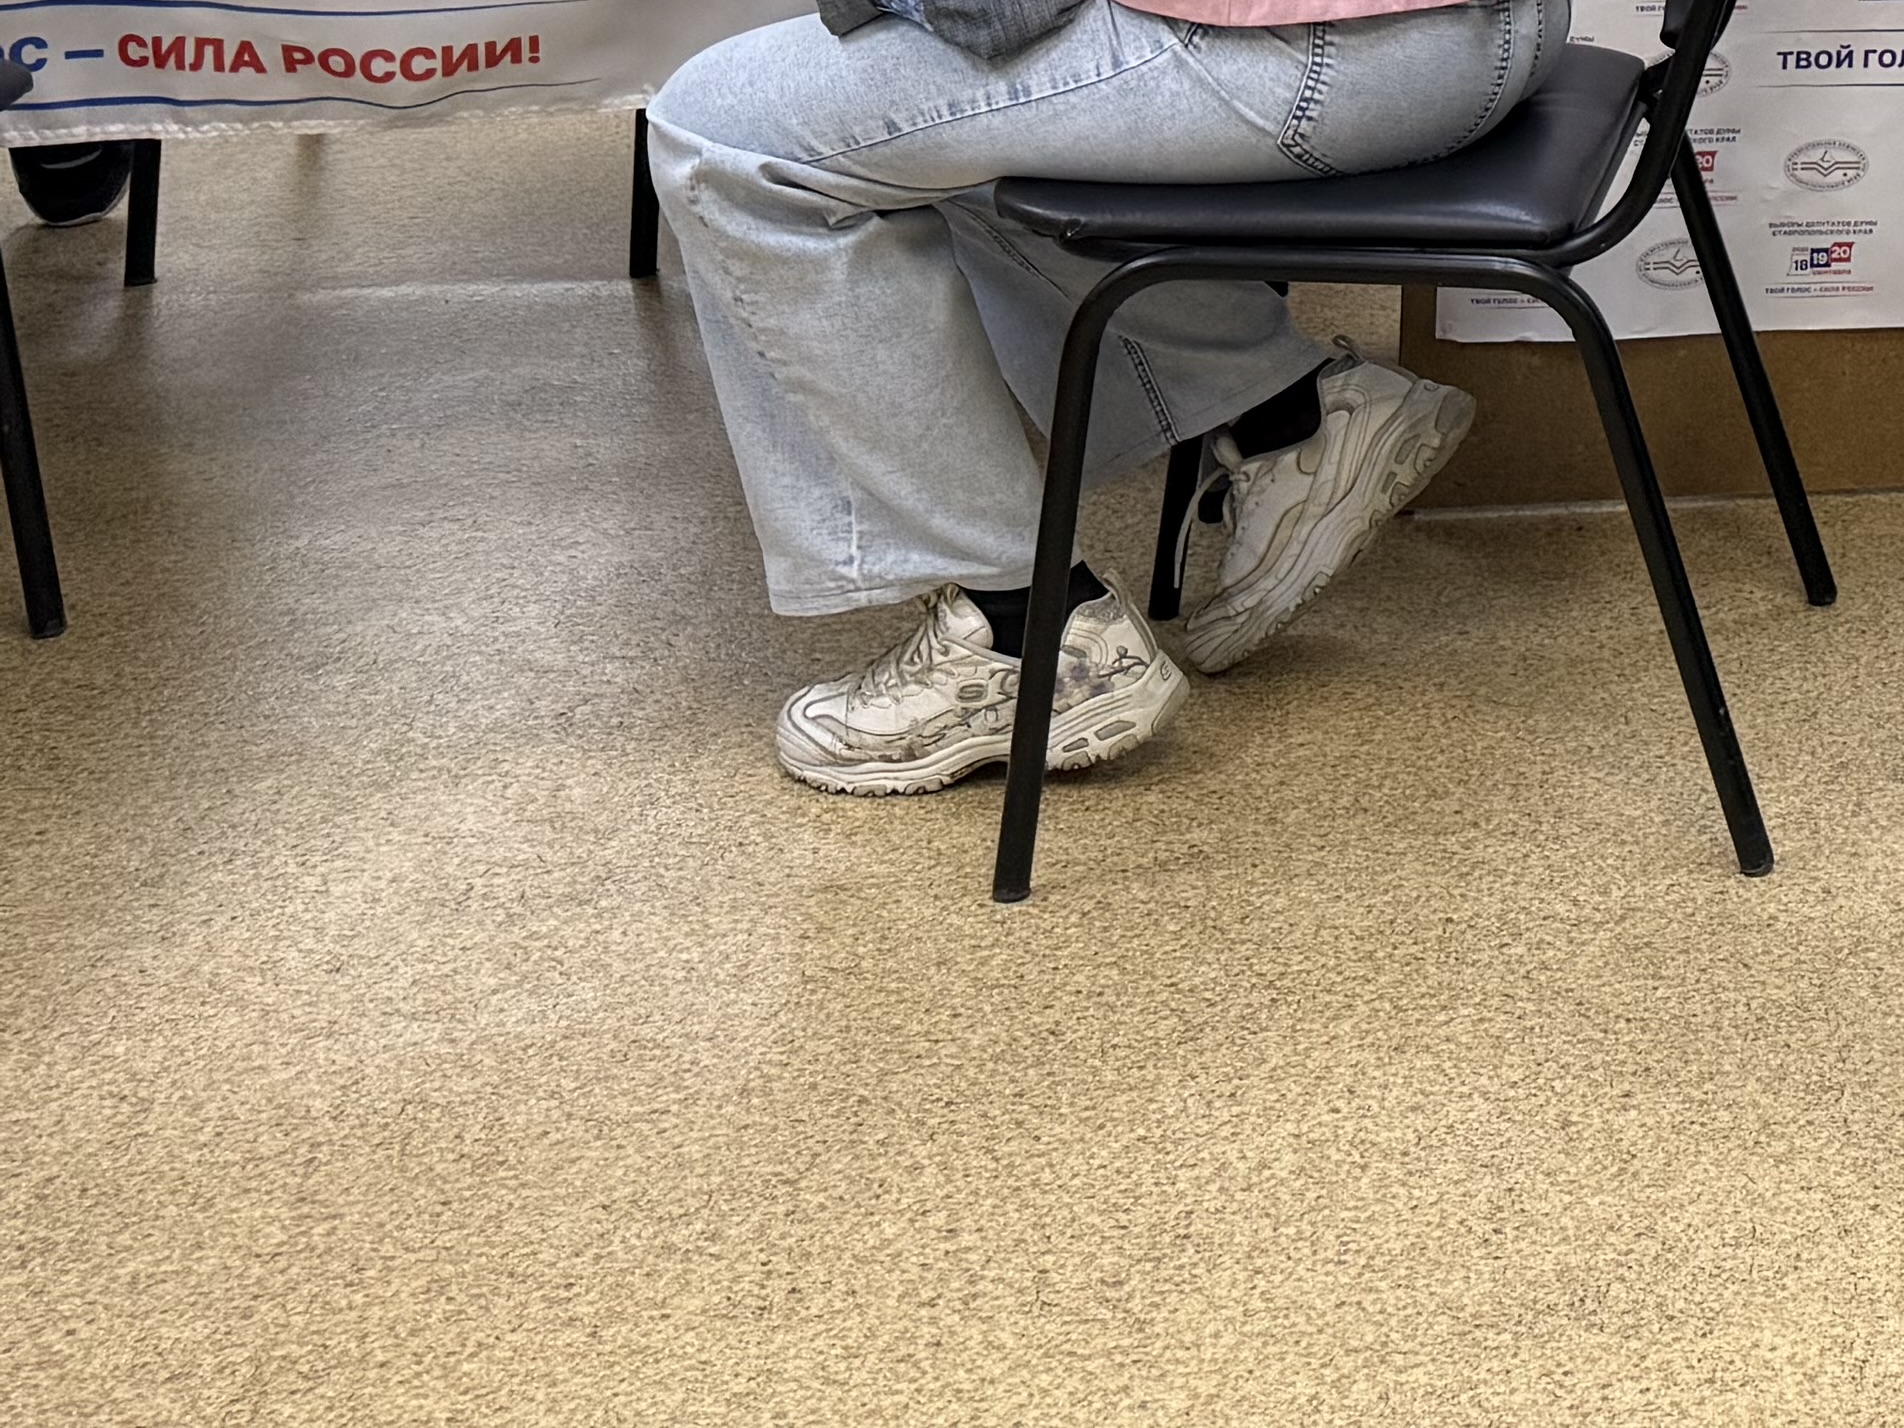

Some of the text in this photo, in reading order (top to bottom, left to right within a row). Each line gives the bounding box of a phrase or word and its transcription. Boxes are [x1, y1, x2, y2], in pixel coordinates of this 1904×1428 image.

[117, 33, 267, 73] СИЛА
[280, 34, 541, 83] РОССИИ!
[1776, 44, 1854, 70] ТВОЙ
[1793, 246, 1850, 272] 18 19 20
